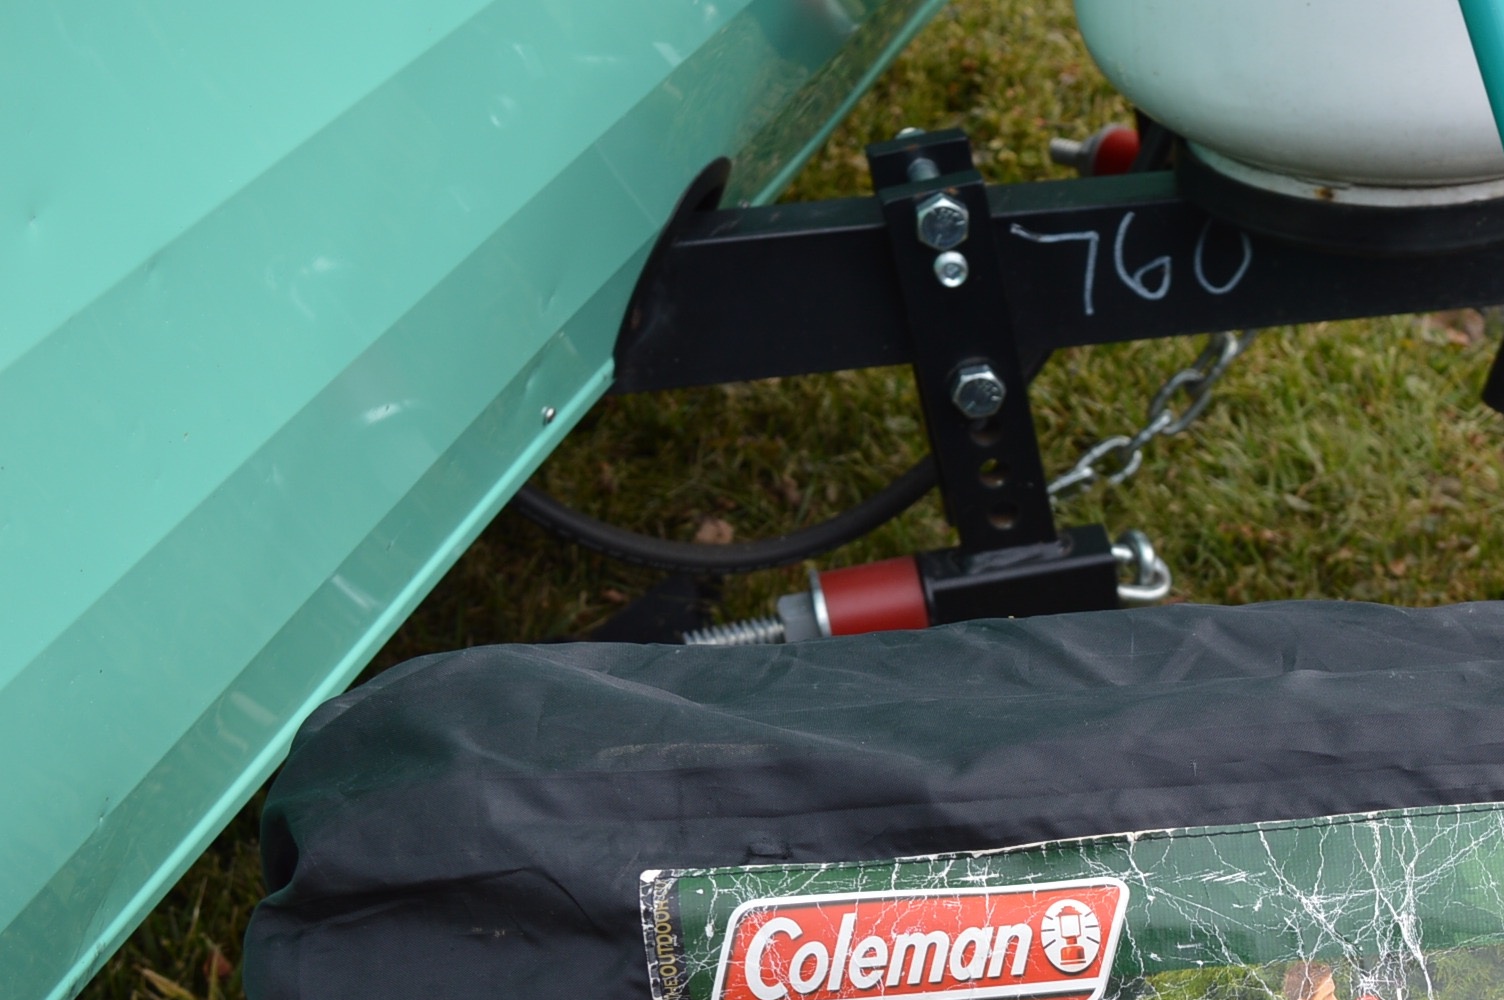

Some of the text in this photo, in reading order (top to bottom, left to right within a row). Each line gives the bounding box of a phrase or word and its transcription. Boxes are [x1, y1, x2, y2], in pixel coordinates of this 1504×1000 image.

[1010, 211, 1252, 315] 760
[655, 898, 678, 977] OUTDOOR
[744, 913, 1032, 1000] Coleman
